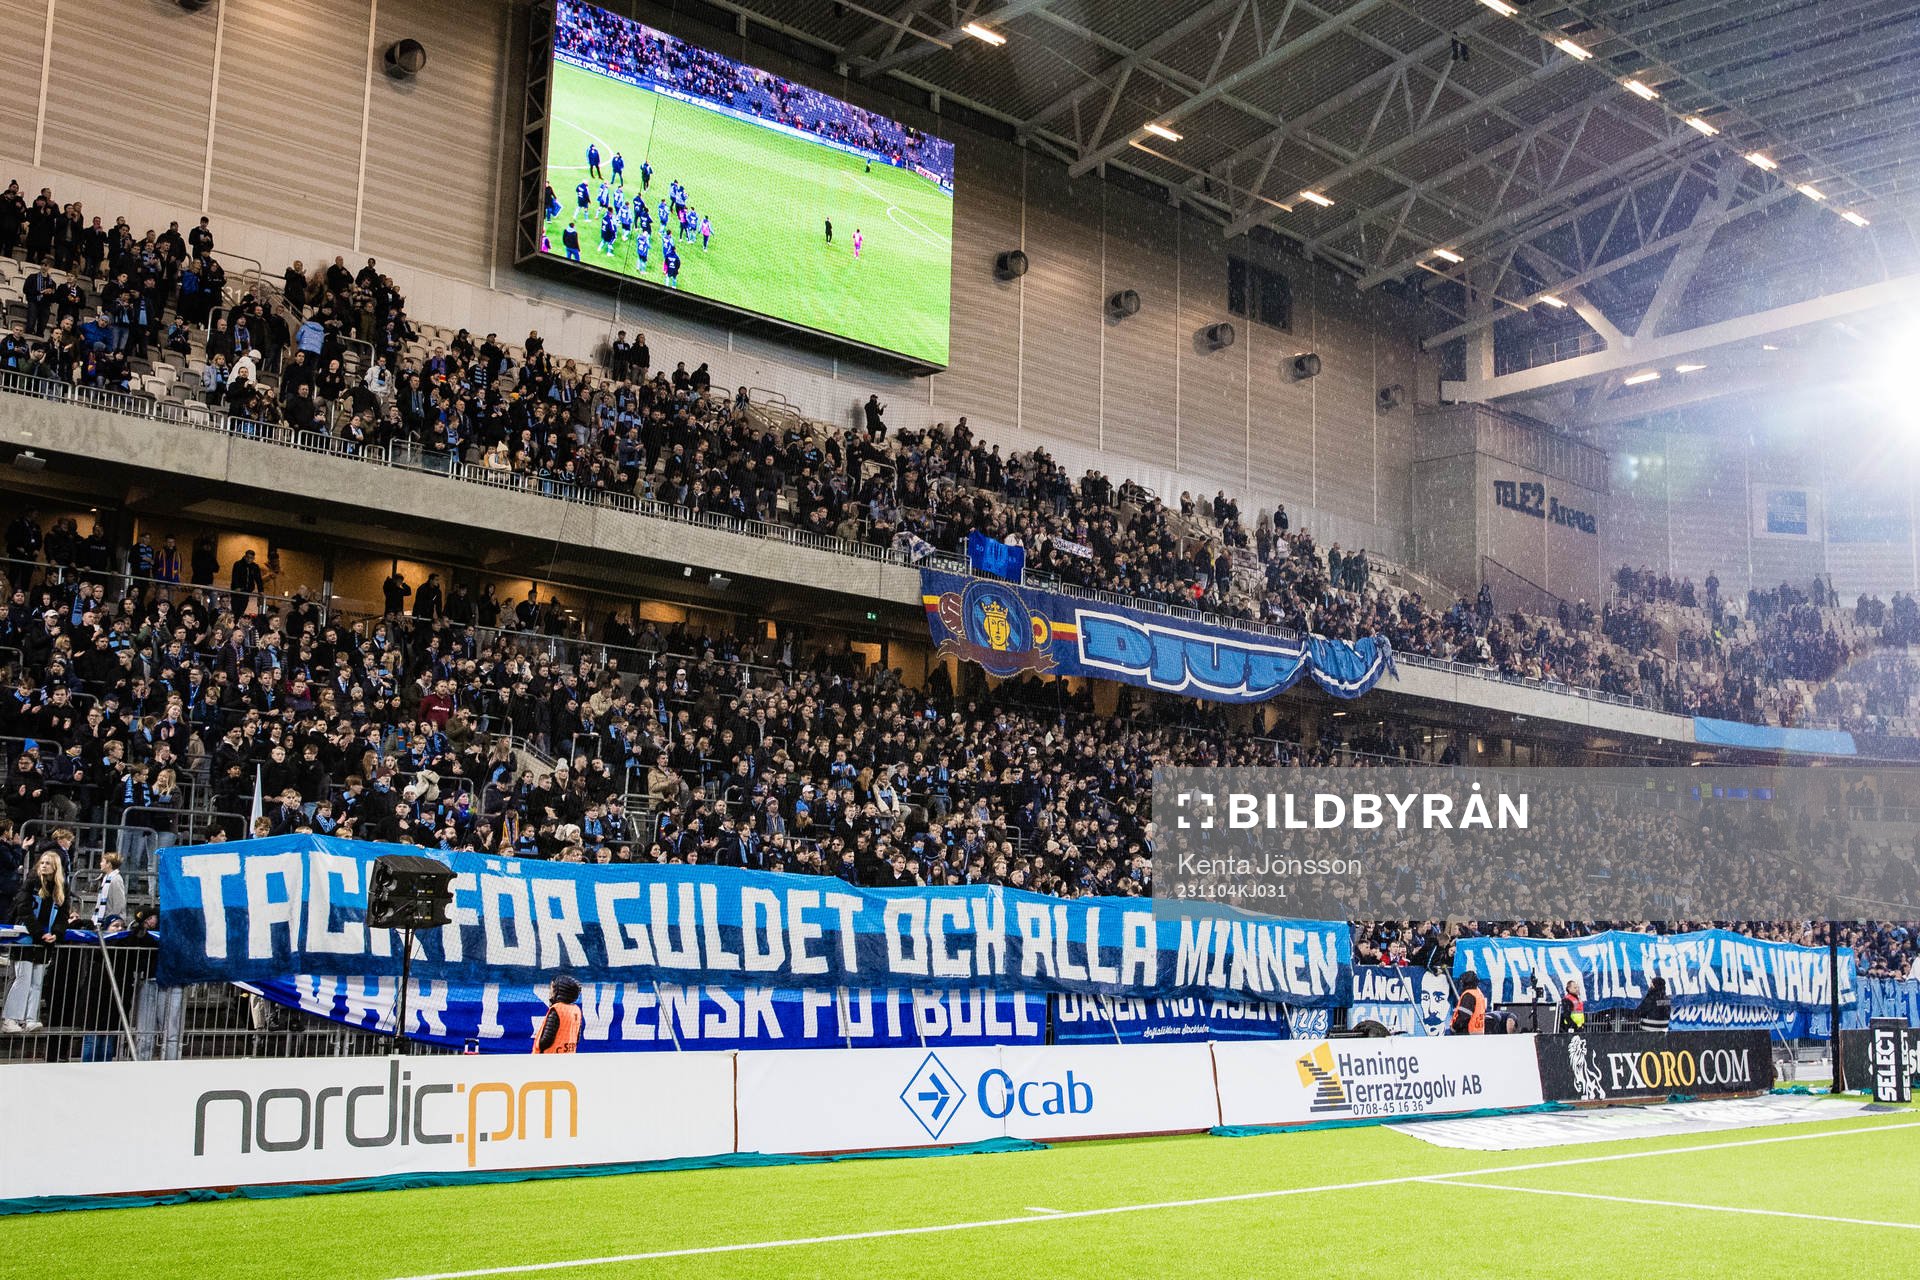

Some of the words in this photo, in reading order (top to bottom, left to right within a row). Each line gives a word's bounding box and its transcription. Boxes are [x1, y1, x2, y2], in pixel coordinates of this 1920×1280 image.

[1549, 497, 1597, 534] Arena
[442, 860, 589, 969] FÖR
[594, 881, 864, 974] GULDET
[883, 897, 1007, 977] OCH
[1017, 902, 1158, 987] ALLA
[1175, 914, 1337, 996] MINNEN
[1353, 969, 1415, 1002] LÅNGA
[1578, 941, 1643, 1001] TILL
[1720, 939, 1772, 999] OCH
[1338, 1051, 1420, 1080] Haninge
[1607, 1049, 1752, 1090] FXORO.COM
[1875, 1029, 1897, 1102] SELECT
[1900, 1030, 1911, 1101] SELECT
[977, 1068, 1094, 1119] Ocab
[1342, 1074, 1456, 1106] Terrazzogolv
[1461, 1074, 1483, 1095] AB
[1353, 1102, 1395, 1116] 0708-45
[1398, 1101, 1410, 1113] 16
[1412, 1100, 1424, 1112] 36
